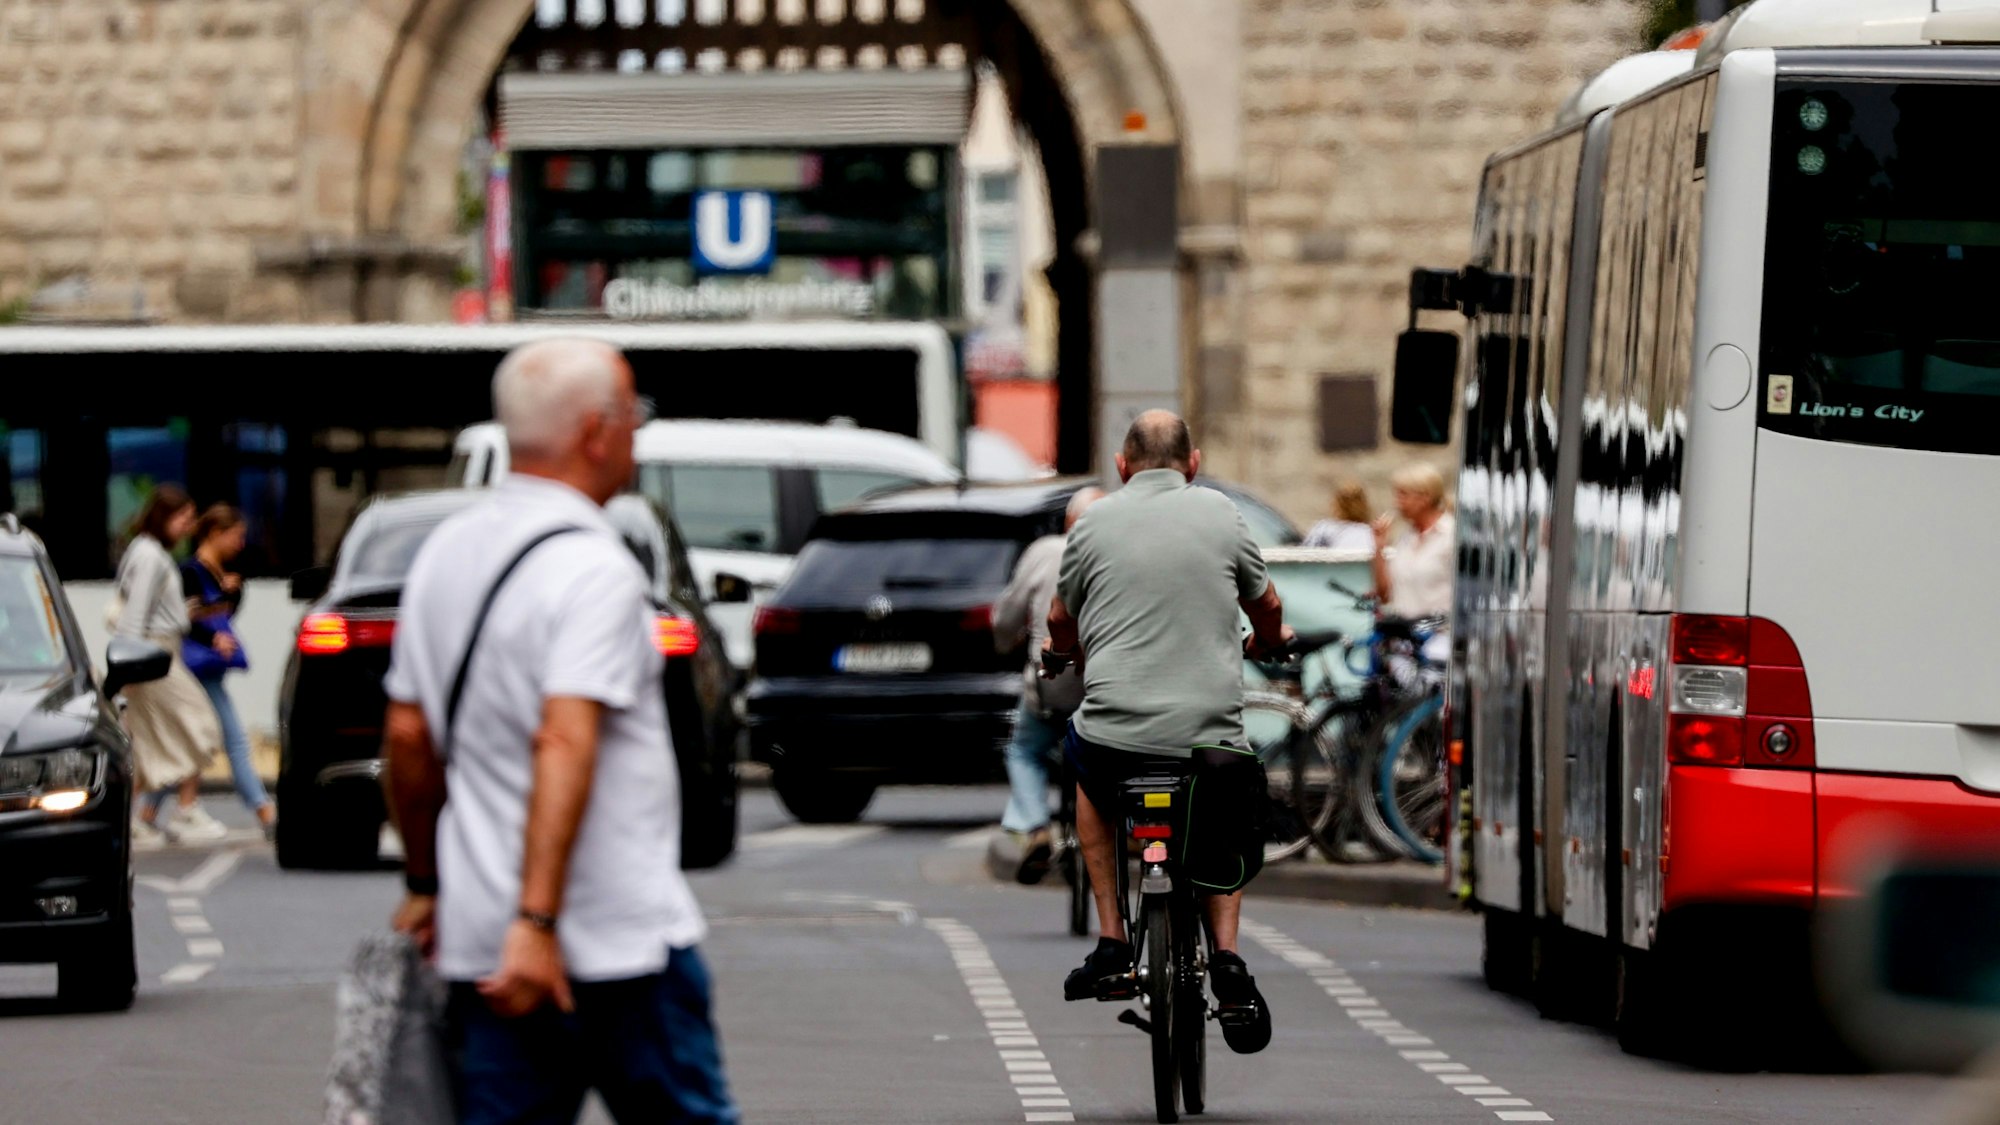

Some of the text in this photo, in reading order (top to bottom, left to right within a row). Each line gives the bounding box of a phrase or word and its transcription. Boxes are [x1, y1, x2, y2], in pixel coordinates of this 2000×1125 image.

[695, 190, 772, 269] U
[1799, 402, 1924, 422] Lion's City
